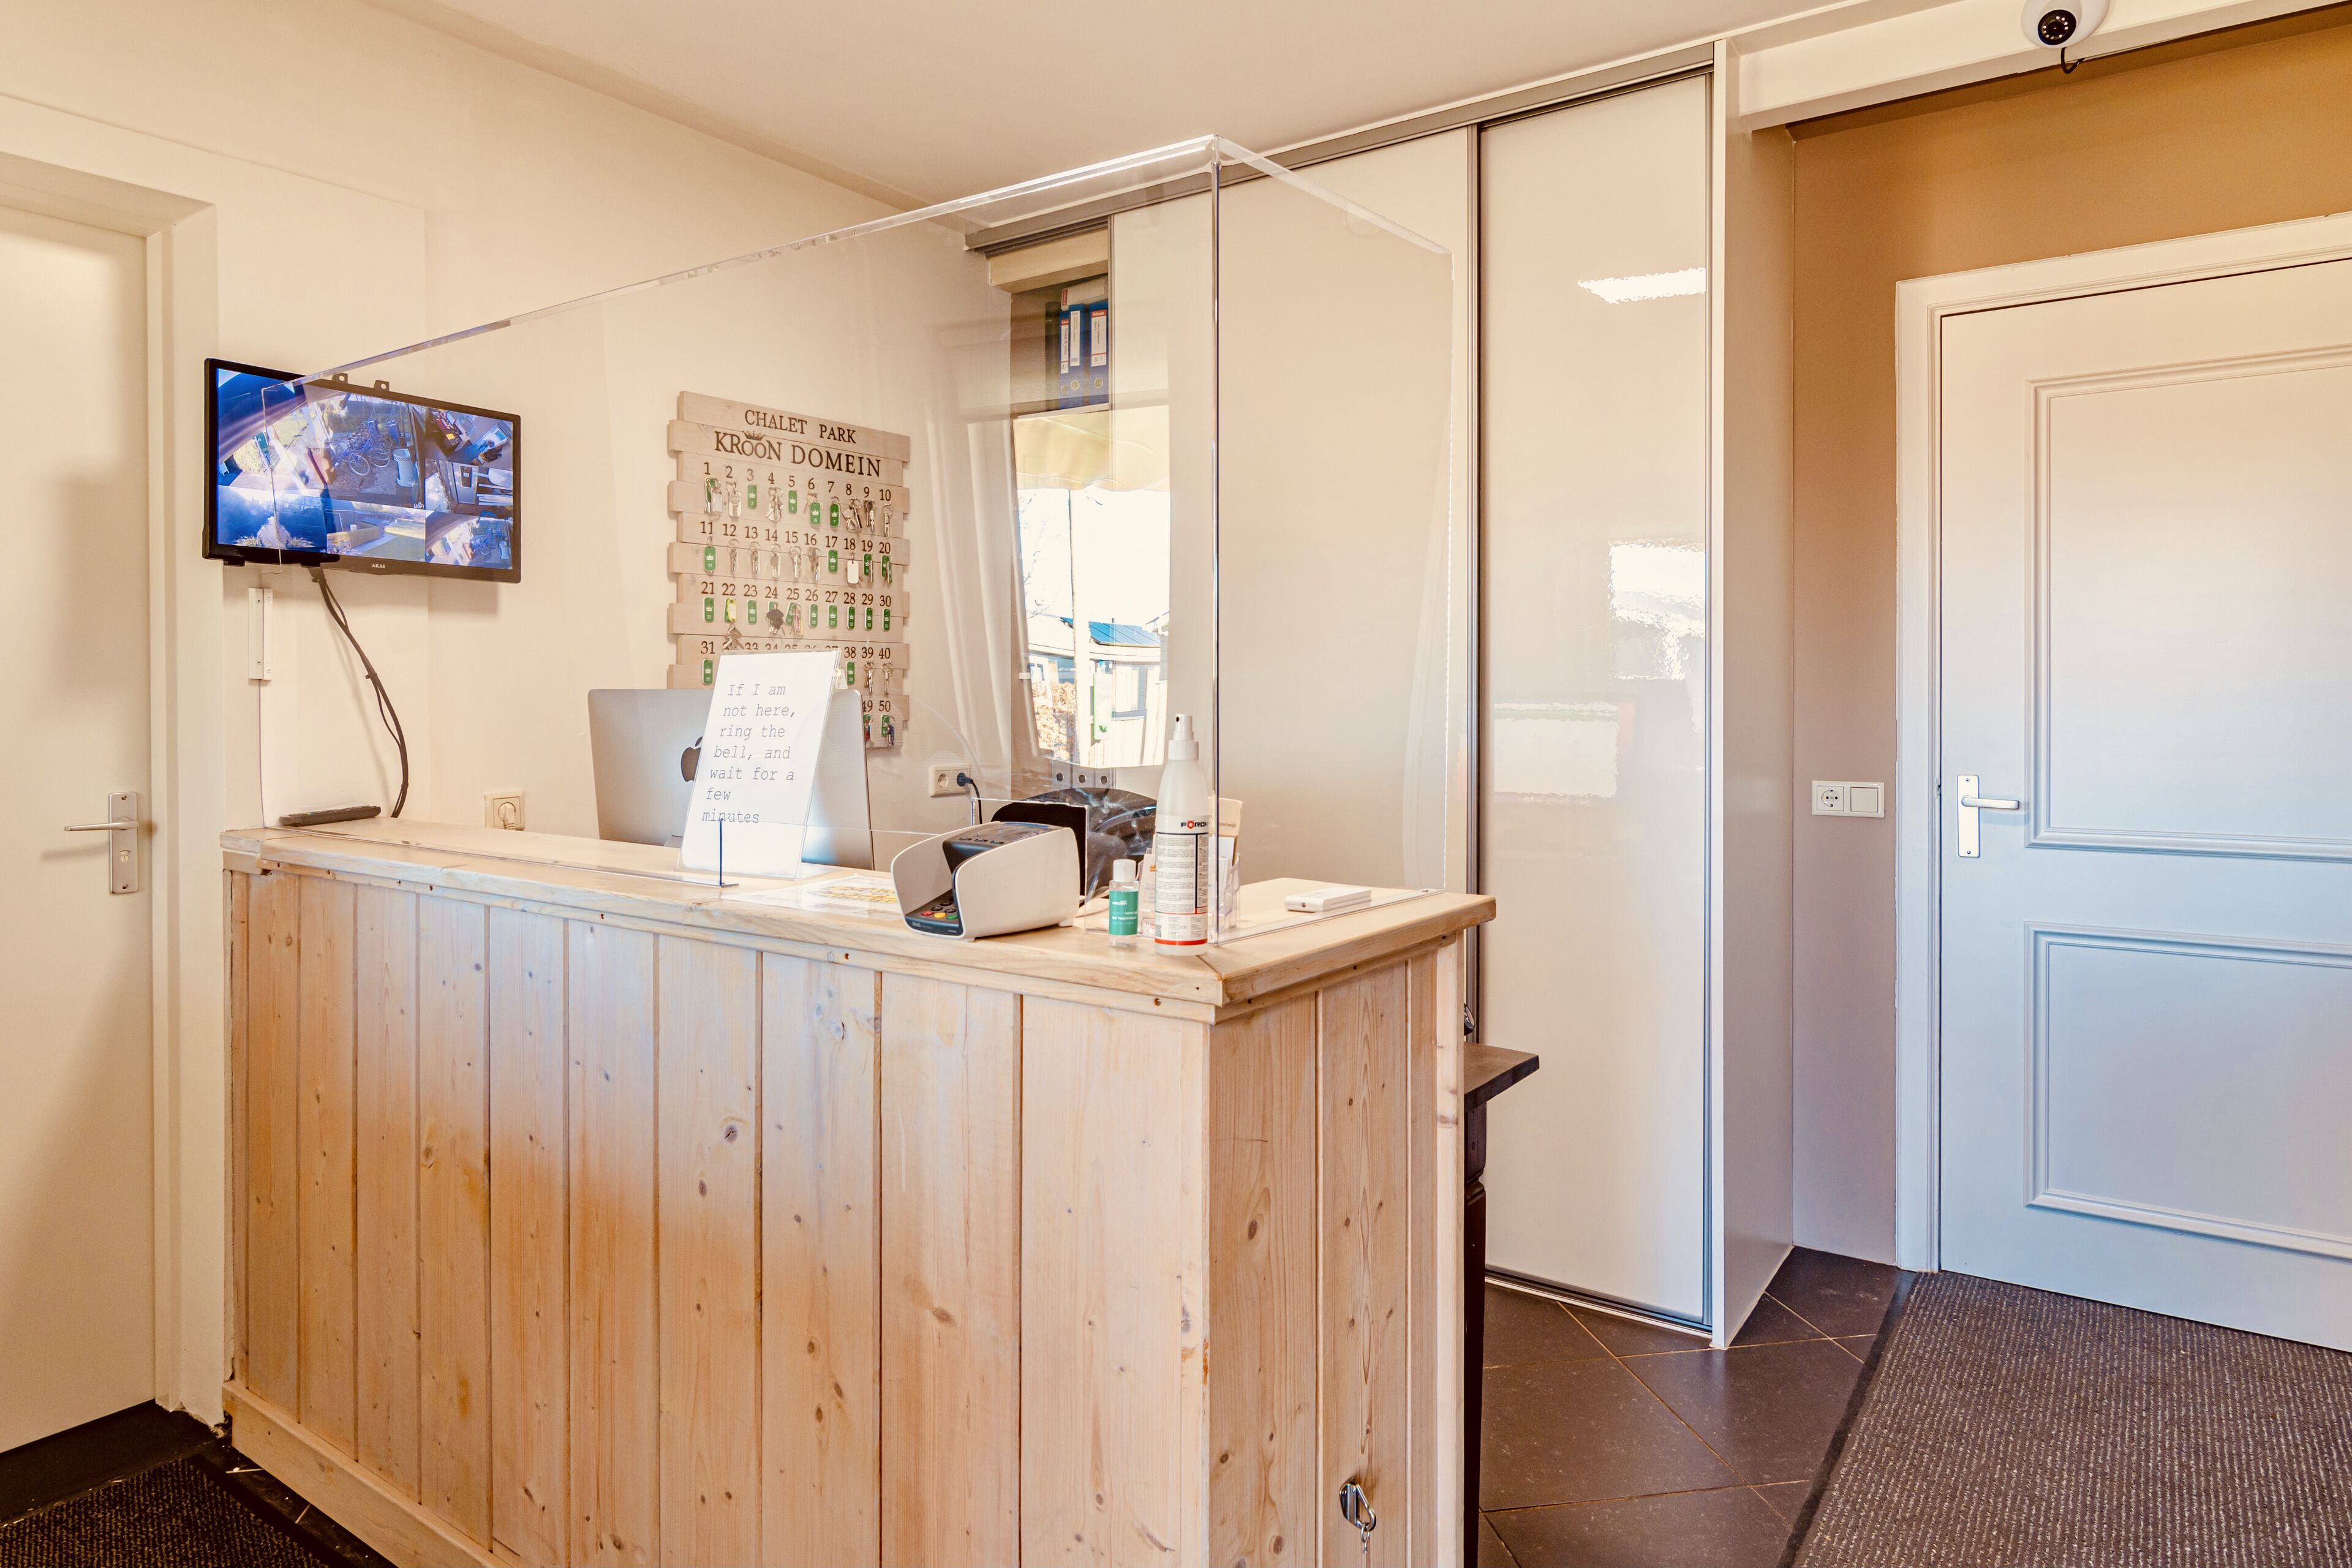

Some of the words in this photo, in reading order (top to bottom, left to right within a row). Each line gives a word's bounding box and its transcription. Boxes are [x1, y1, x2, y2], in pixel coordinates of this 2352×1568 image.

[745, 409, 807, 434] CHALET
[819, 424, 856, 444] PARK
[714, 431, 782, 461] KROON
[791, 444, 881, 477] DOMEIN
[704, 462, 710, 475] 1
[726, 466, 733, 478] 2
[747, 469, 754, 481] 3
[768, 472, 775, 484] 4
[788, 475, 795, 488] 5
[808, 478, 815, 490] 6
[827, 481, 835, 492] 7
[846, 483, 852, 496] 8
[864, 486, 870, 498] 9
[879, 489, 891, 502] 10
[700, 521, 713, 535] 11
[722, 523, 737, 537] 12
[744, 526, 758, 539] 13
[765, 529, 778, 542] 14
[785, 531, 799, 544] 15
[804, 533, 817, 546] 16
[825, 535, 838, 548] 17
[843, 538, 856, 551] 18
[861, 540, 873, 552] 19
[879, 541, 891, 554] 20
[701, 581, 715, 595] 21
[722, 582, 736, 596] 22
[744, 584, 758, 597] 23
[764, 586, 778, 599] 24
[786, 587, 800, 600] 25
[805, 589, 818, 601] 26
[825, 590, 838, 603] 27
[843, 592, 856, 605] 28
[861, 594, 873, 606] 29
[880, 595, 892, 608] 30
[700, 641, 715, 654] 31
[843, 646, 856, 658] 38
[861, 647, 873, 659] 39
[878, 647, 891, 660] 40
[728, 684, 745, 696] If
[752, 684, 760, 695] I
[769, 685, 786, 695] am
[723, 705, 746, 717] not
[755, 704, 795, 718] here,
[878, 700, 891, 712] 50
[718, 725, 752, 741] ring
[761, 725, 785, 737] the
[713, 745, 752, 760] bell,
[764, 746, 791, 759] and
[710, 766, 742, 780] wait
[753, 767, 778, 780] for
[786, 771, 794, 781] a
[706, 787, 731, 801] few
[701, 809, 760, 823] minutes
